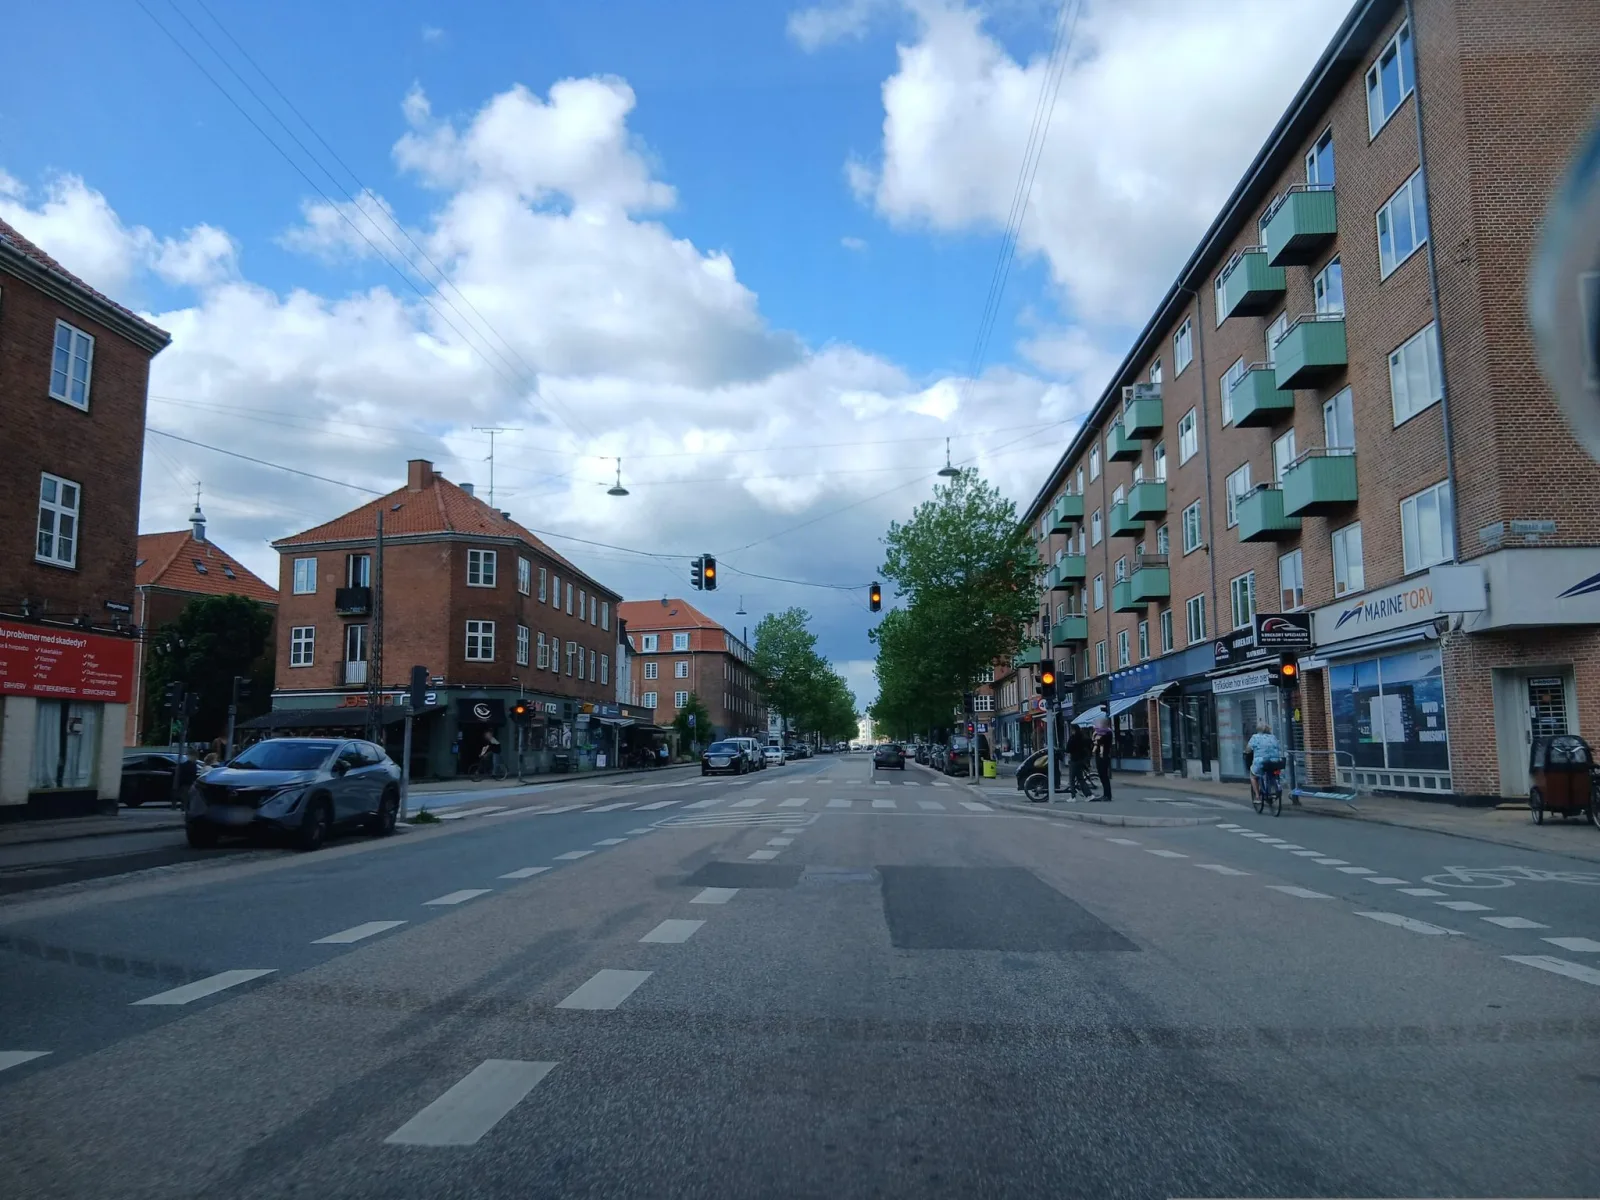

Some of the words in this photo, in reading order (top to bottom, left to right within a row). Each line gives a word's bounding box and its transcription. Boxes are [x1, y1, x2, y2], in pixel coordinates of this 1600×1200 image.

[1365, 586, 1433, 622] MARINETORV
[6, 630, 40, 642] problemer
[41, 635, 56, 643] med
[56, 636, 87, 649] skadedyr?
